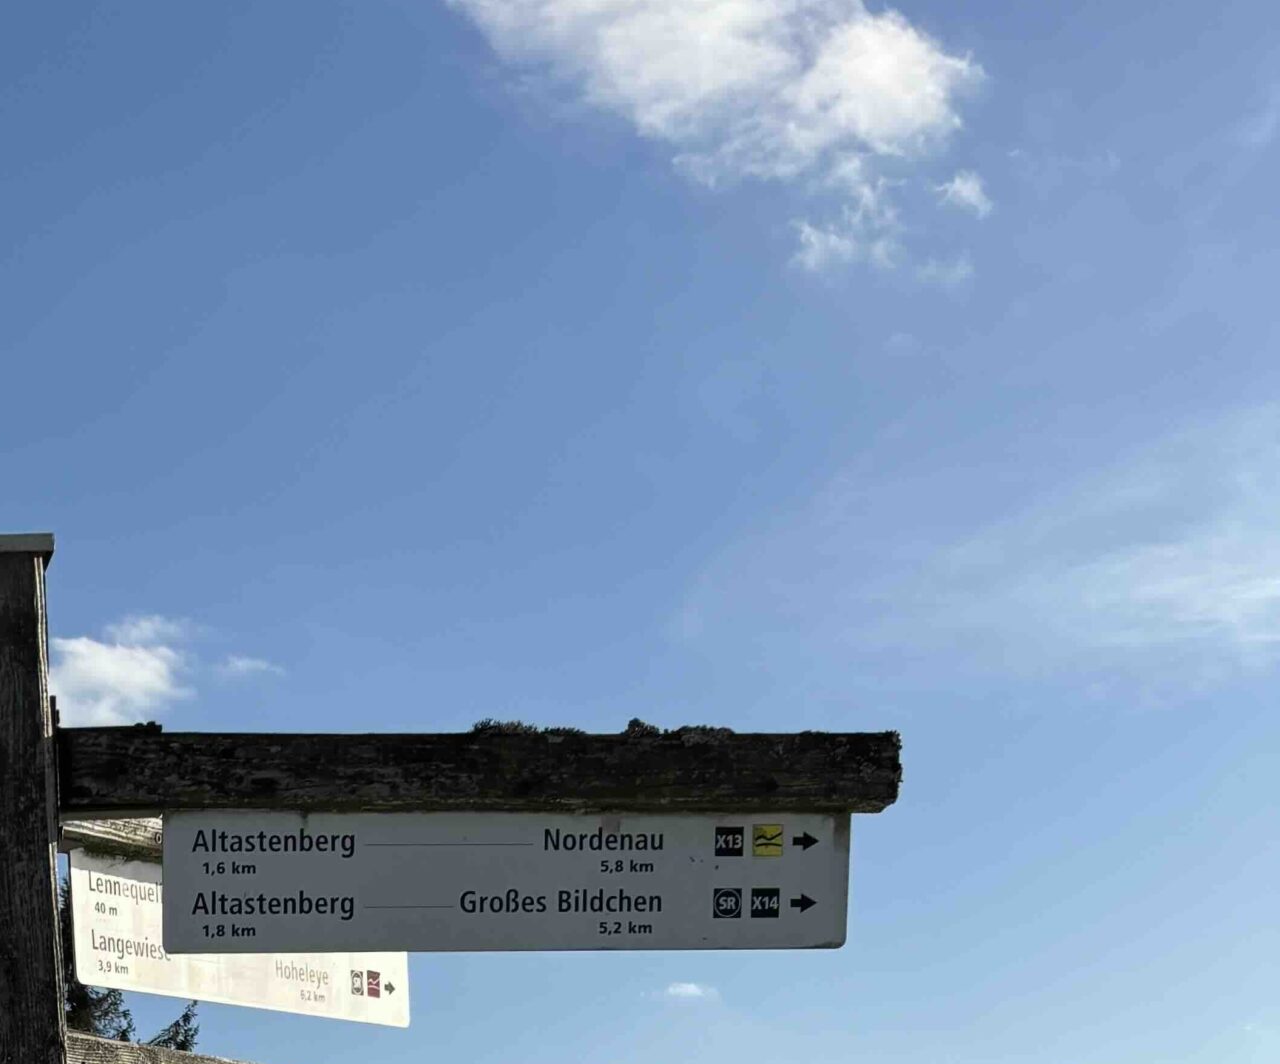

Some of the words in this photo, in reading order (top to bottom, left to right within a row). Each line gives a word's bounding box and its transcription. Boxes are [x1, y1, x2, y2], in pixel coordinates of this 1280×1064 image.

[192, 828, 355, 858] Altastenberg
[543, 828, 664, 851] Nordenau
[716, 834, 742, 849] X13
[202, 862, 226, 876] 1,6
[231, 861, 256, 875] km
[600, 860, 623, 875] 5,8
[629, 859, 654, 873] km
[88, 869, 163, 905] Lennequel
[192, 890, 354, 920] Altastenberg
[459, 889, 547, 913] Großes
[558, 888, 662, 913] Bildchen
[719, 896, 736, 910] SR
[752, 895, 779, 910] X14
[94, 901, 106, 914] 40
[109, 906, 118, 916] m
[202, 925, 225, 939] 1,8
[231, 924, 256, 937] km
[599, 921, 622, 935] 5,2
[628, 920, 653, 934] km
[98, 960, 112, 973] 3,9
[114, 962, 129, 975] km
[275, 960, 329, 990] Hoheleye
